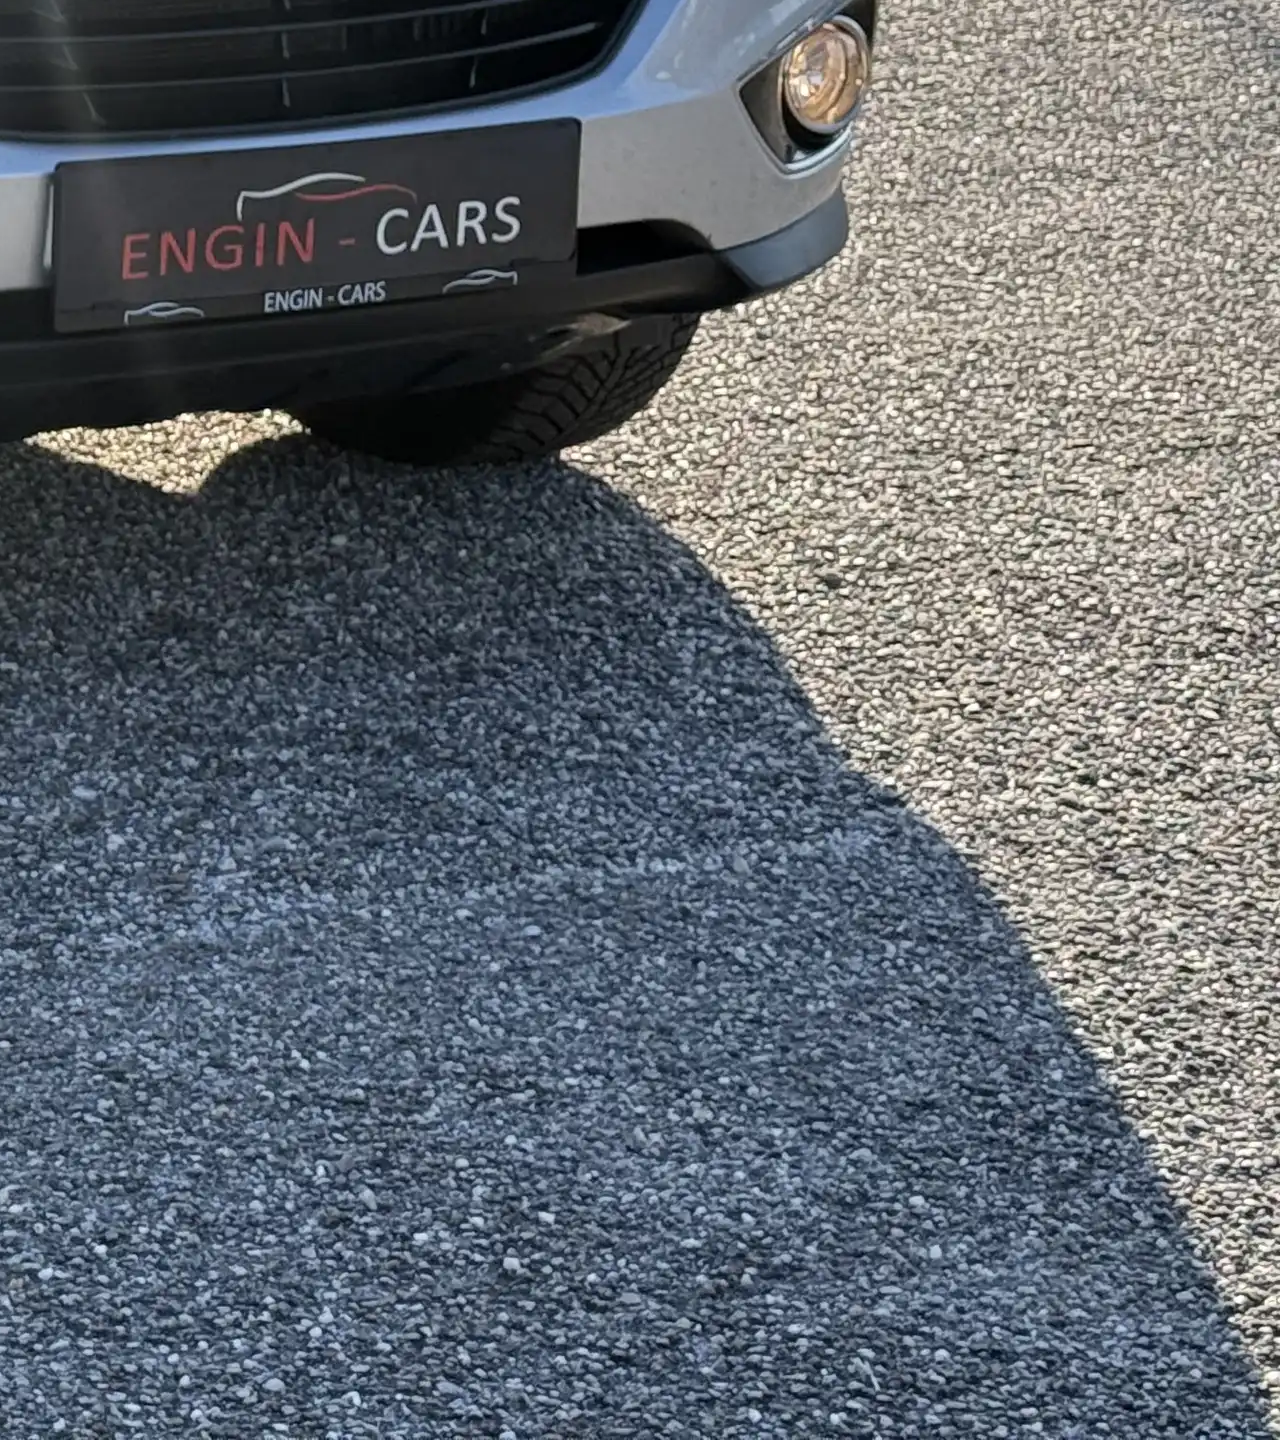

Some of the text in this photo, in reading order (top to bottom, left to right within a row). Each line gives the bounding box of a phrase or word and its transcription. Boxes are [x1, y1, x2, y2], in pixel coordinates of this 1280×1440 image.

[121, 217, 315, 280] ENGIN
[375, 195, 522, 256] CARS
[263, 287, 324, 313] ENGIN
[337, 281, 386, 306] CARS
